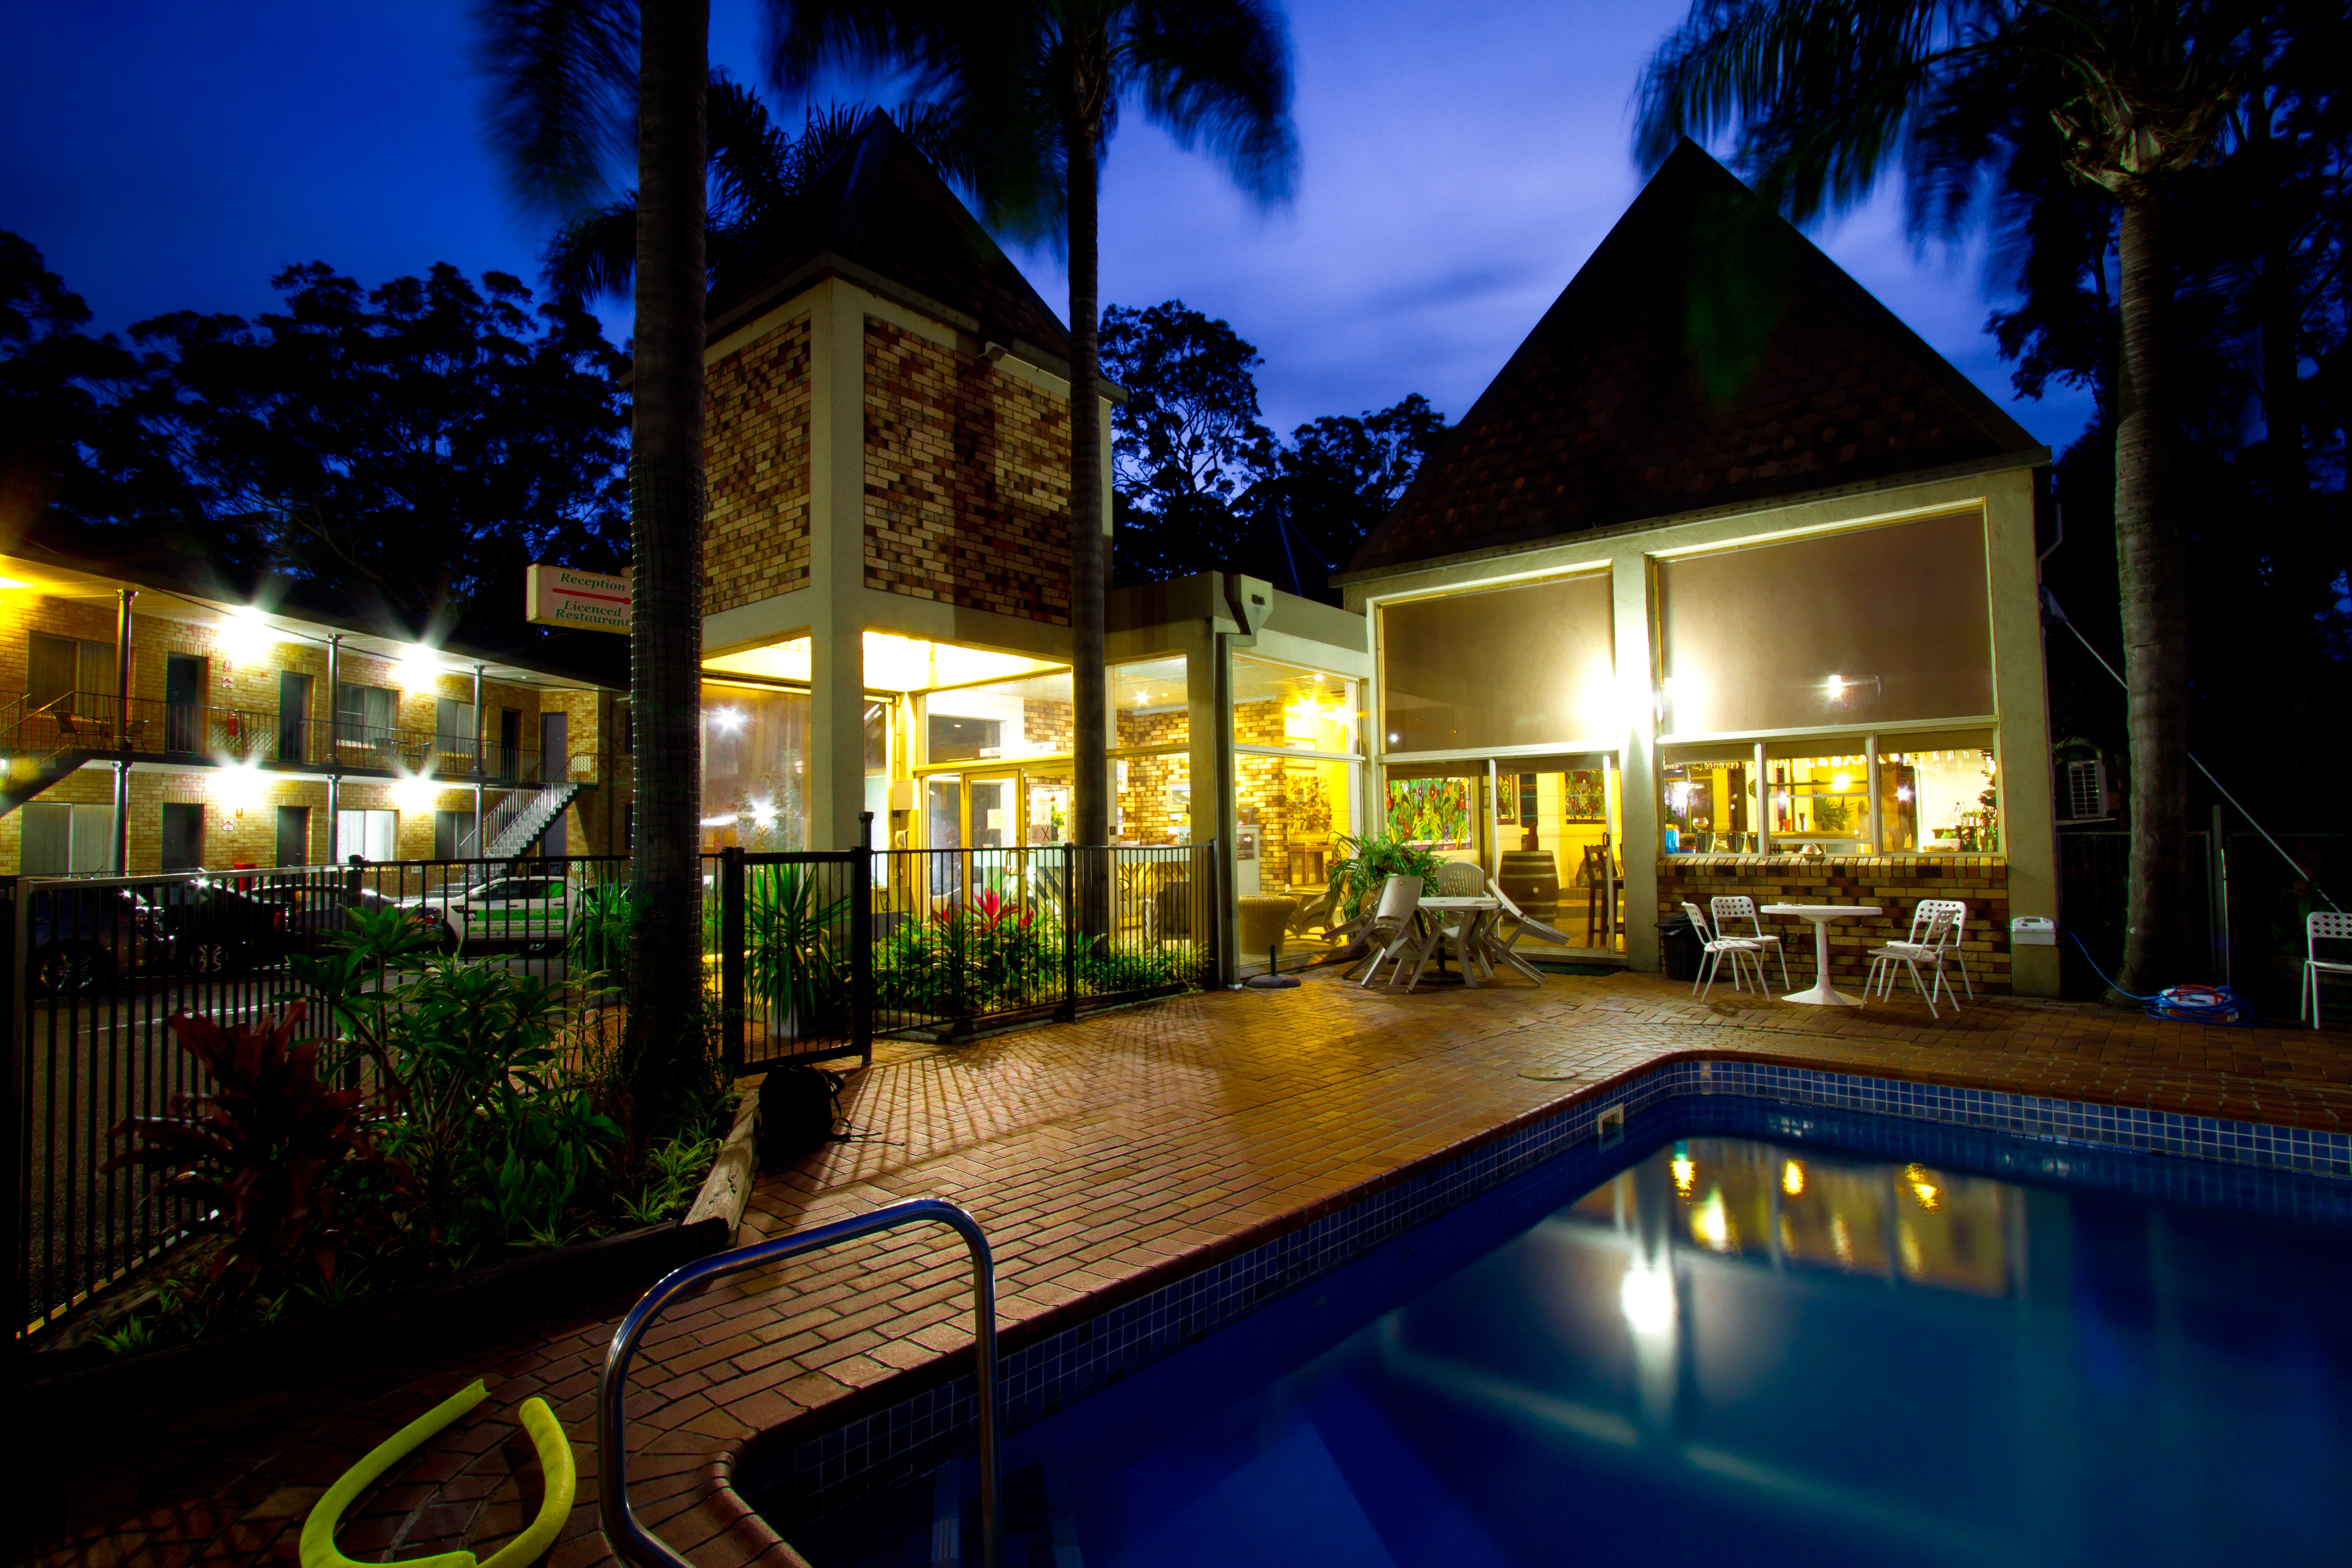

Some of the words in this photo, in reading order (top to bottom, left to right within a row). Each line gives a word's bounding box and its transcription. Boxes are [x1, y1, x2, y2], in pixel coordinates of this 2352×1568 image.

[560, 573, 625, 591] Reception
[555, 608, 630, 627] Restaurant
[564, 600, 621, 617] Licenced
